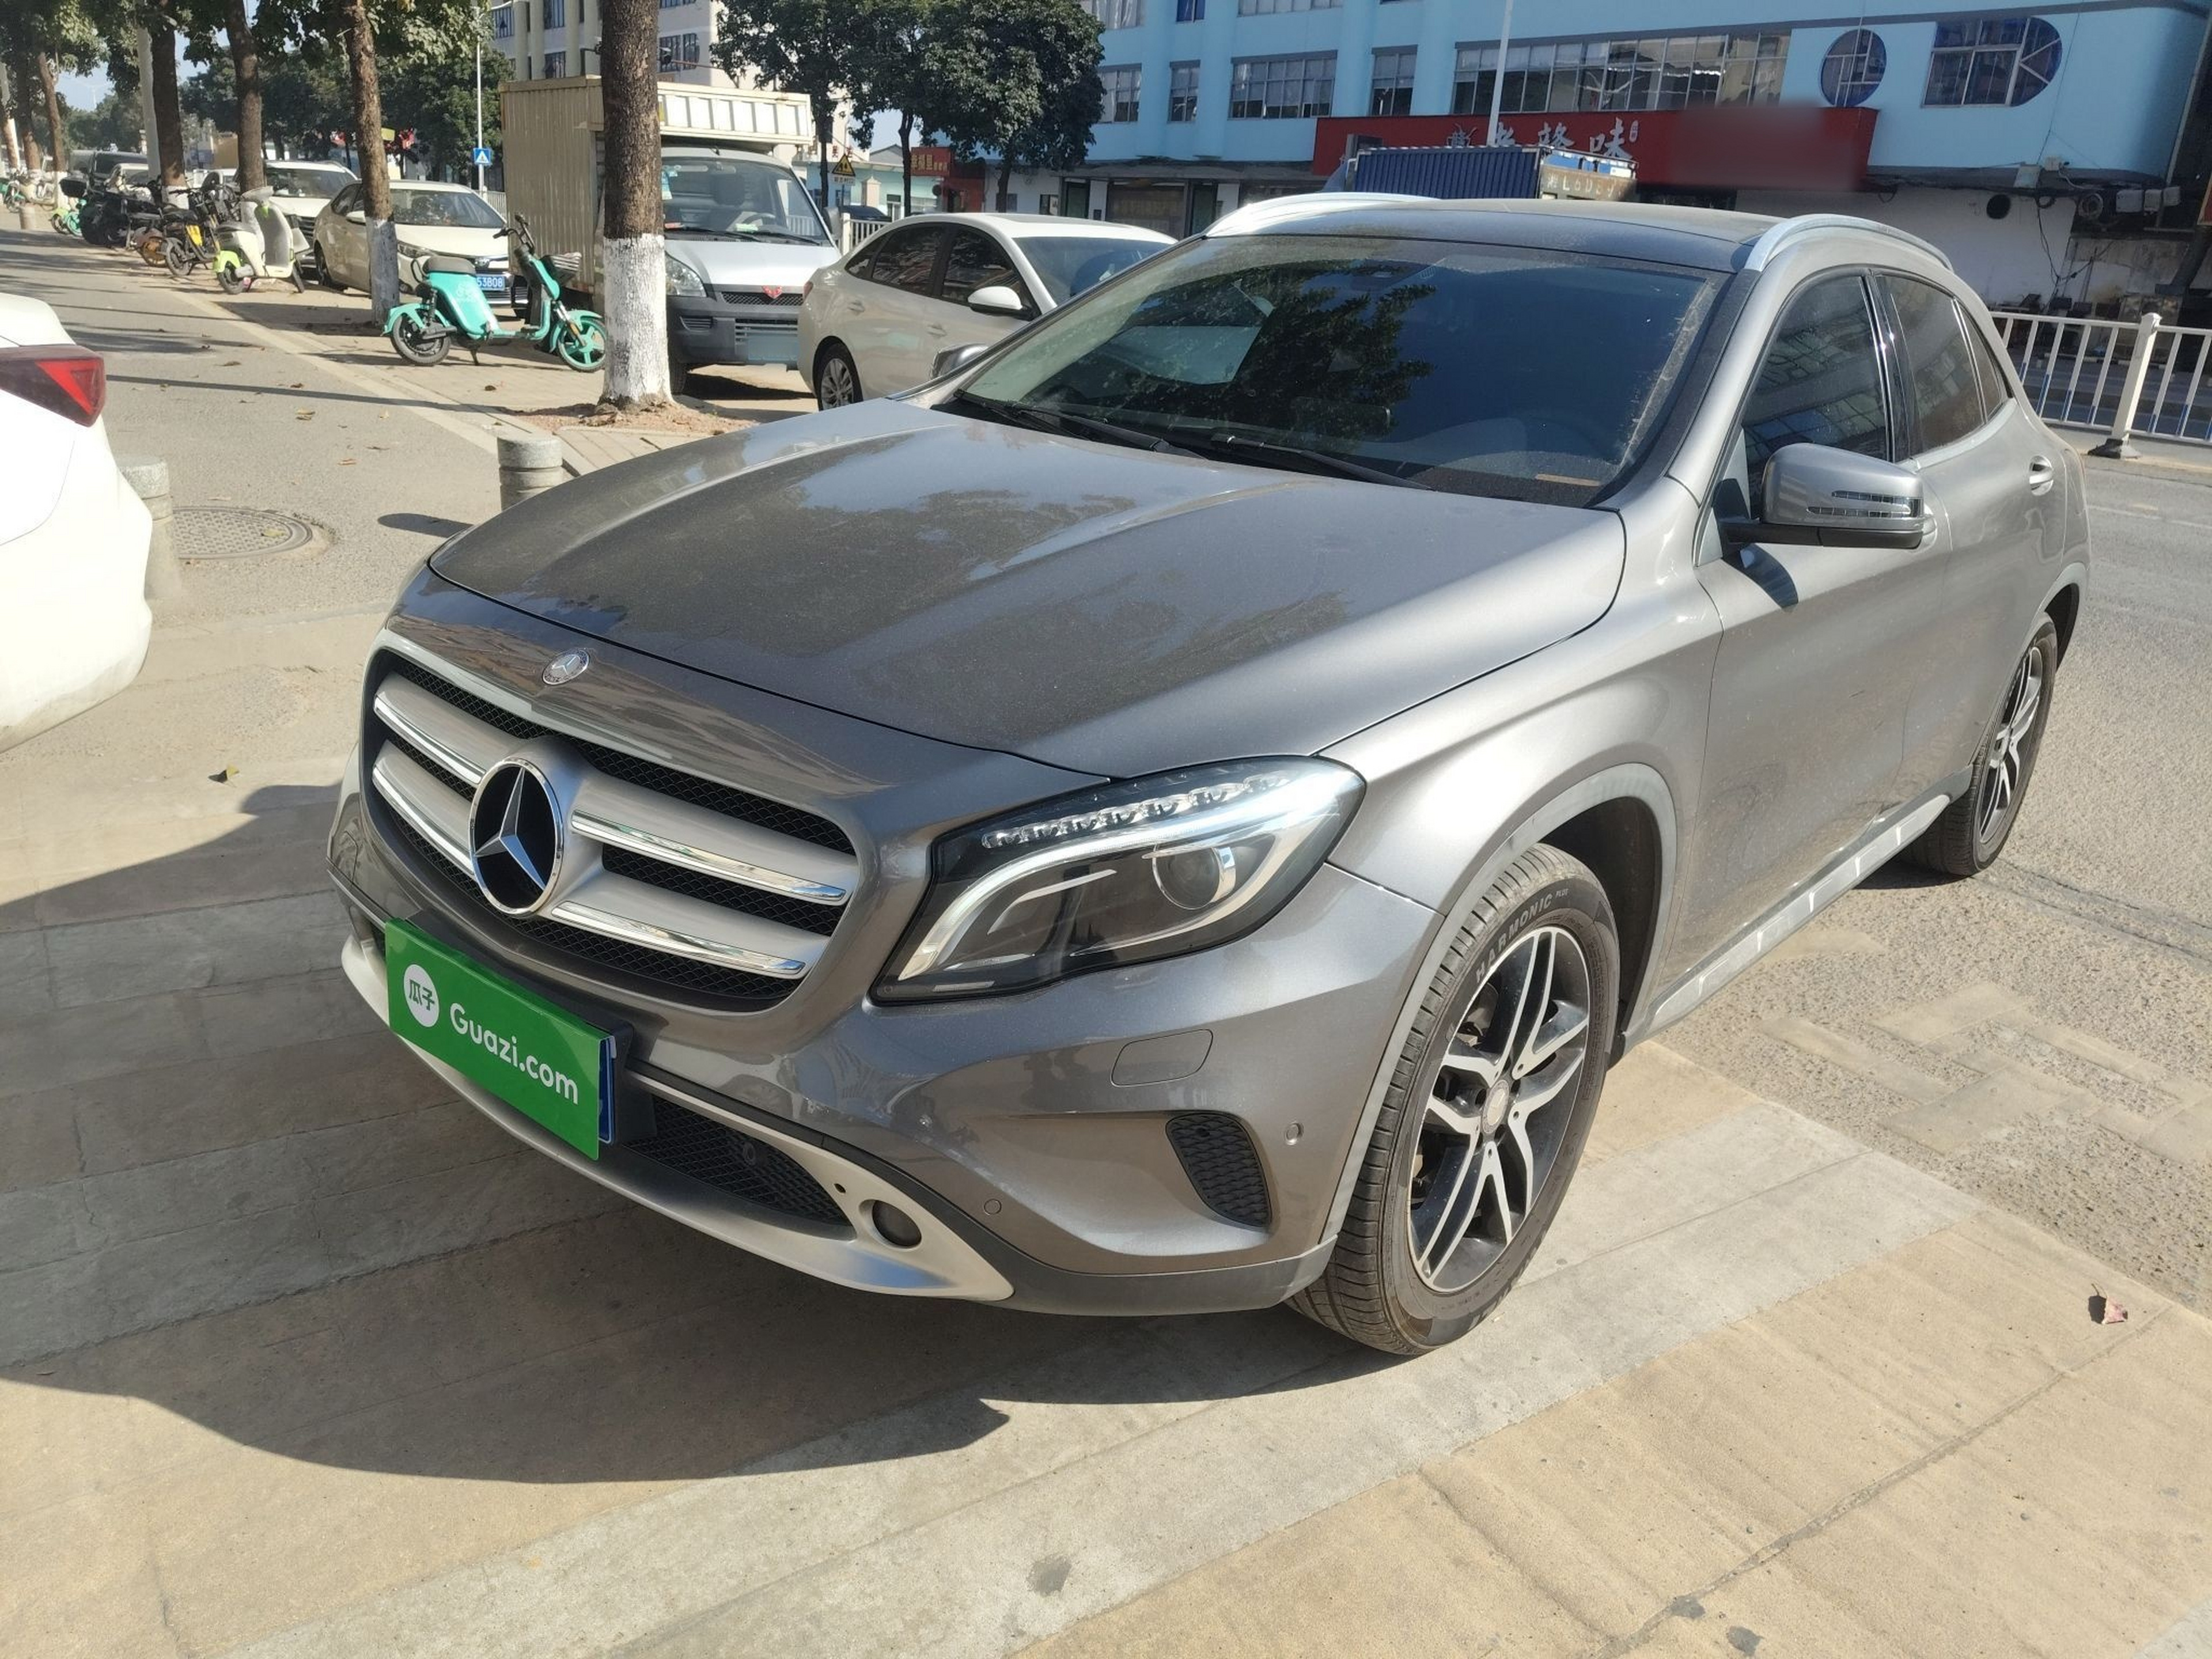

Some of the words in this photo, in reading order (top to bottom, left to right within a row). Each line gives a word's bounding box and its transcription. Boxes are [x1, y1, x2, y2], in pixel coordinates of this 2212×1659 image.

[1476, 893, 1553, 983] HARMONIC
[408, 978, 435, 1011] 瓜子
[450, 1003, 578, 1105] Guazi.com
